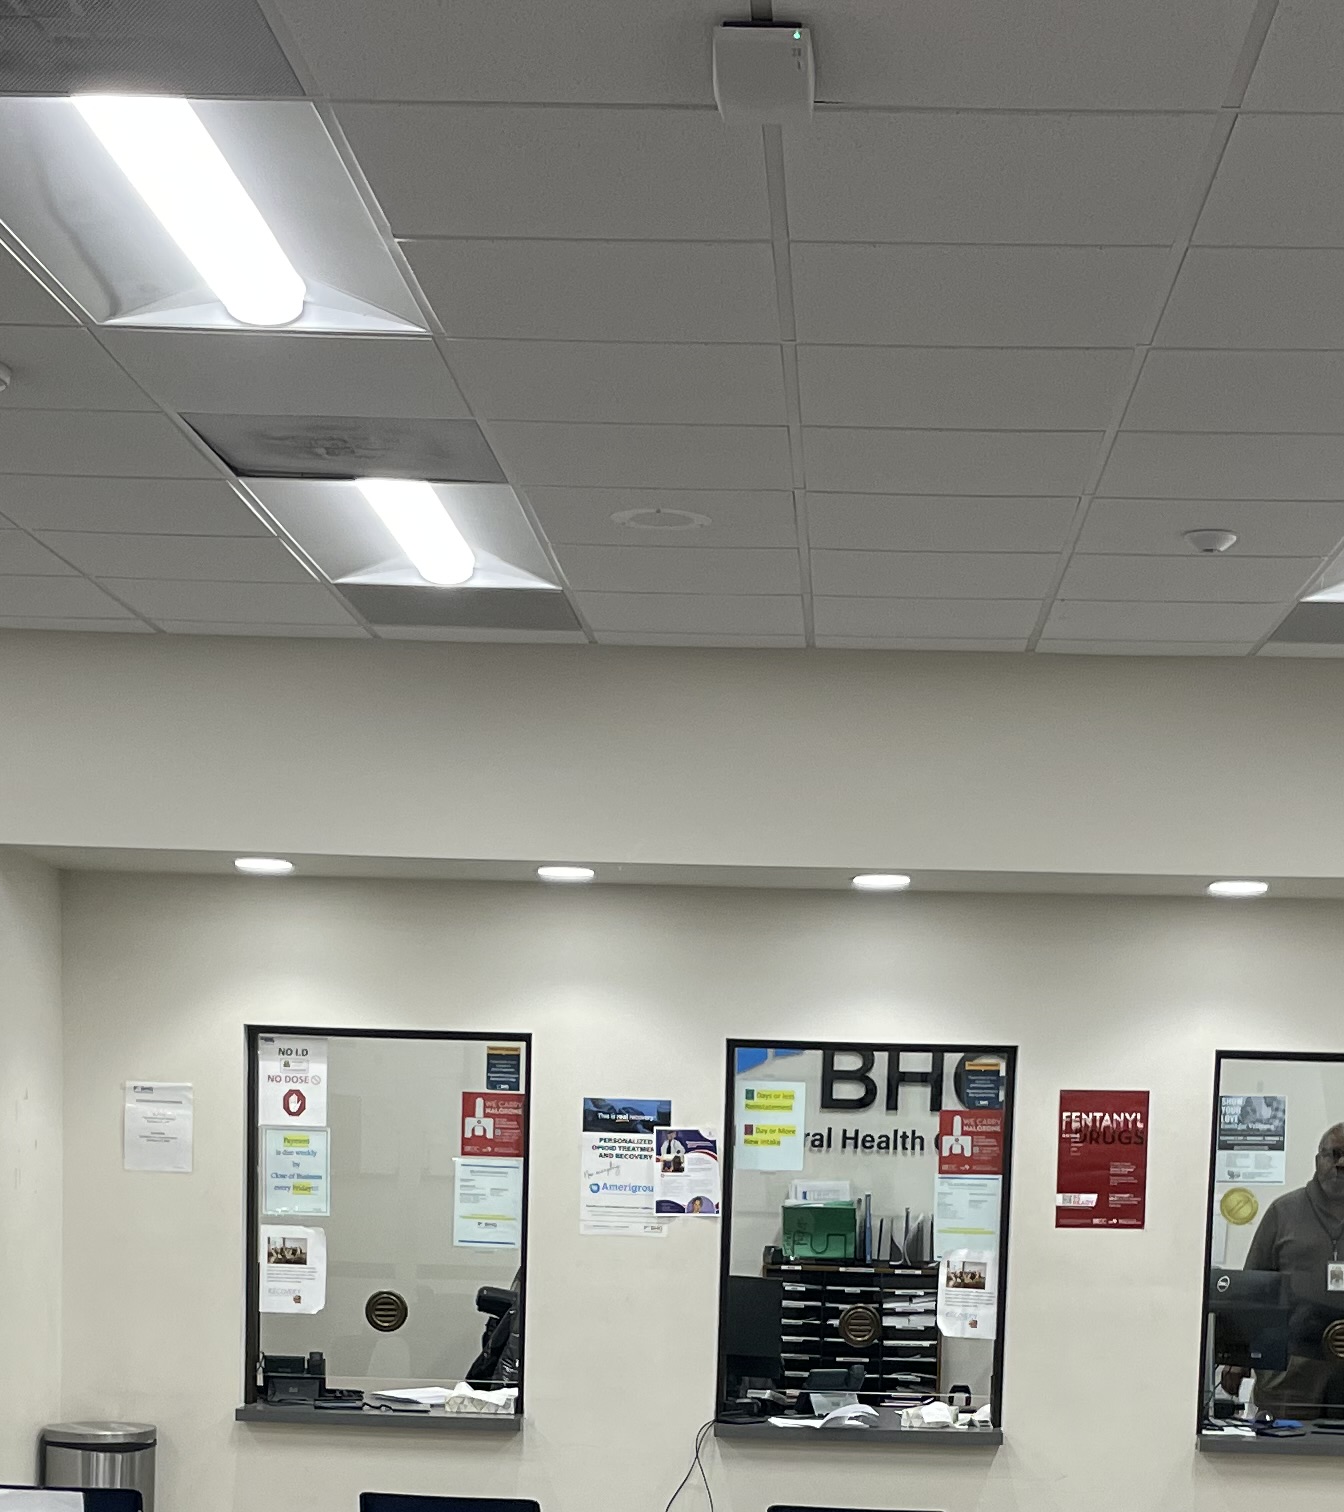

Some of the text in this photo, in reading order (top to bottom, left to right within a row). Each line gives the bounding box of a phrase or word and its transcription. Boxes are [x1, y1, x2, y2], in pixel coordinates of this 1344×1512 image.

[278, 1048, 293, 1056] NO
[268, 1074, 310, 1084] NO DOSE
[1062, 1112, 1144, 1132] FENTANYL
[841, 1128, 925, 1151] Health
[1075, 1129, 1144, 1146] DRUGS
[292, 1160, 300, 1168] by
[602, 1182, 654, 1194] Amerigrou
